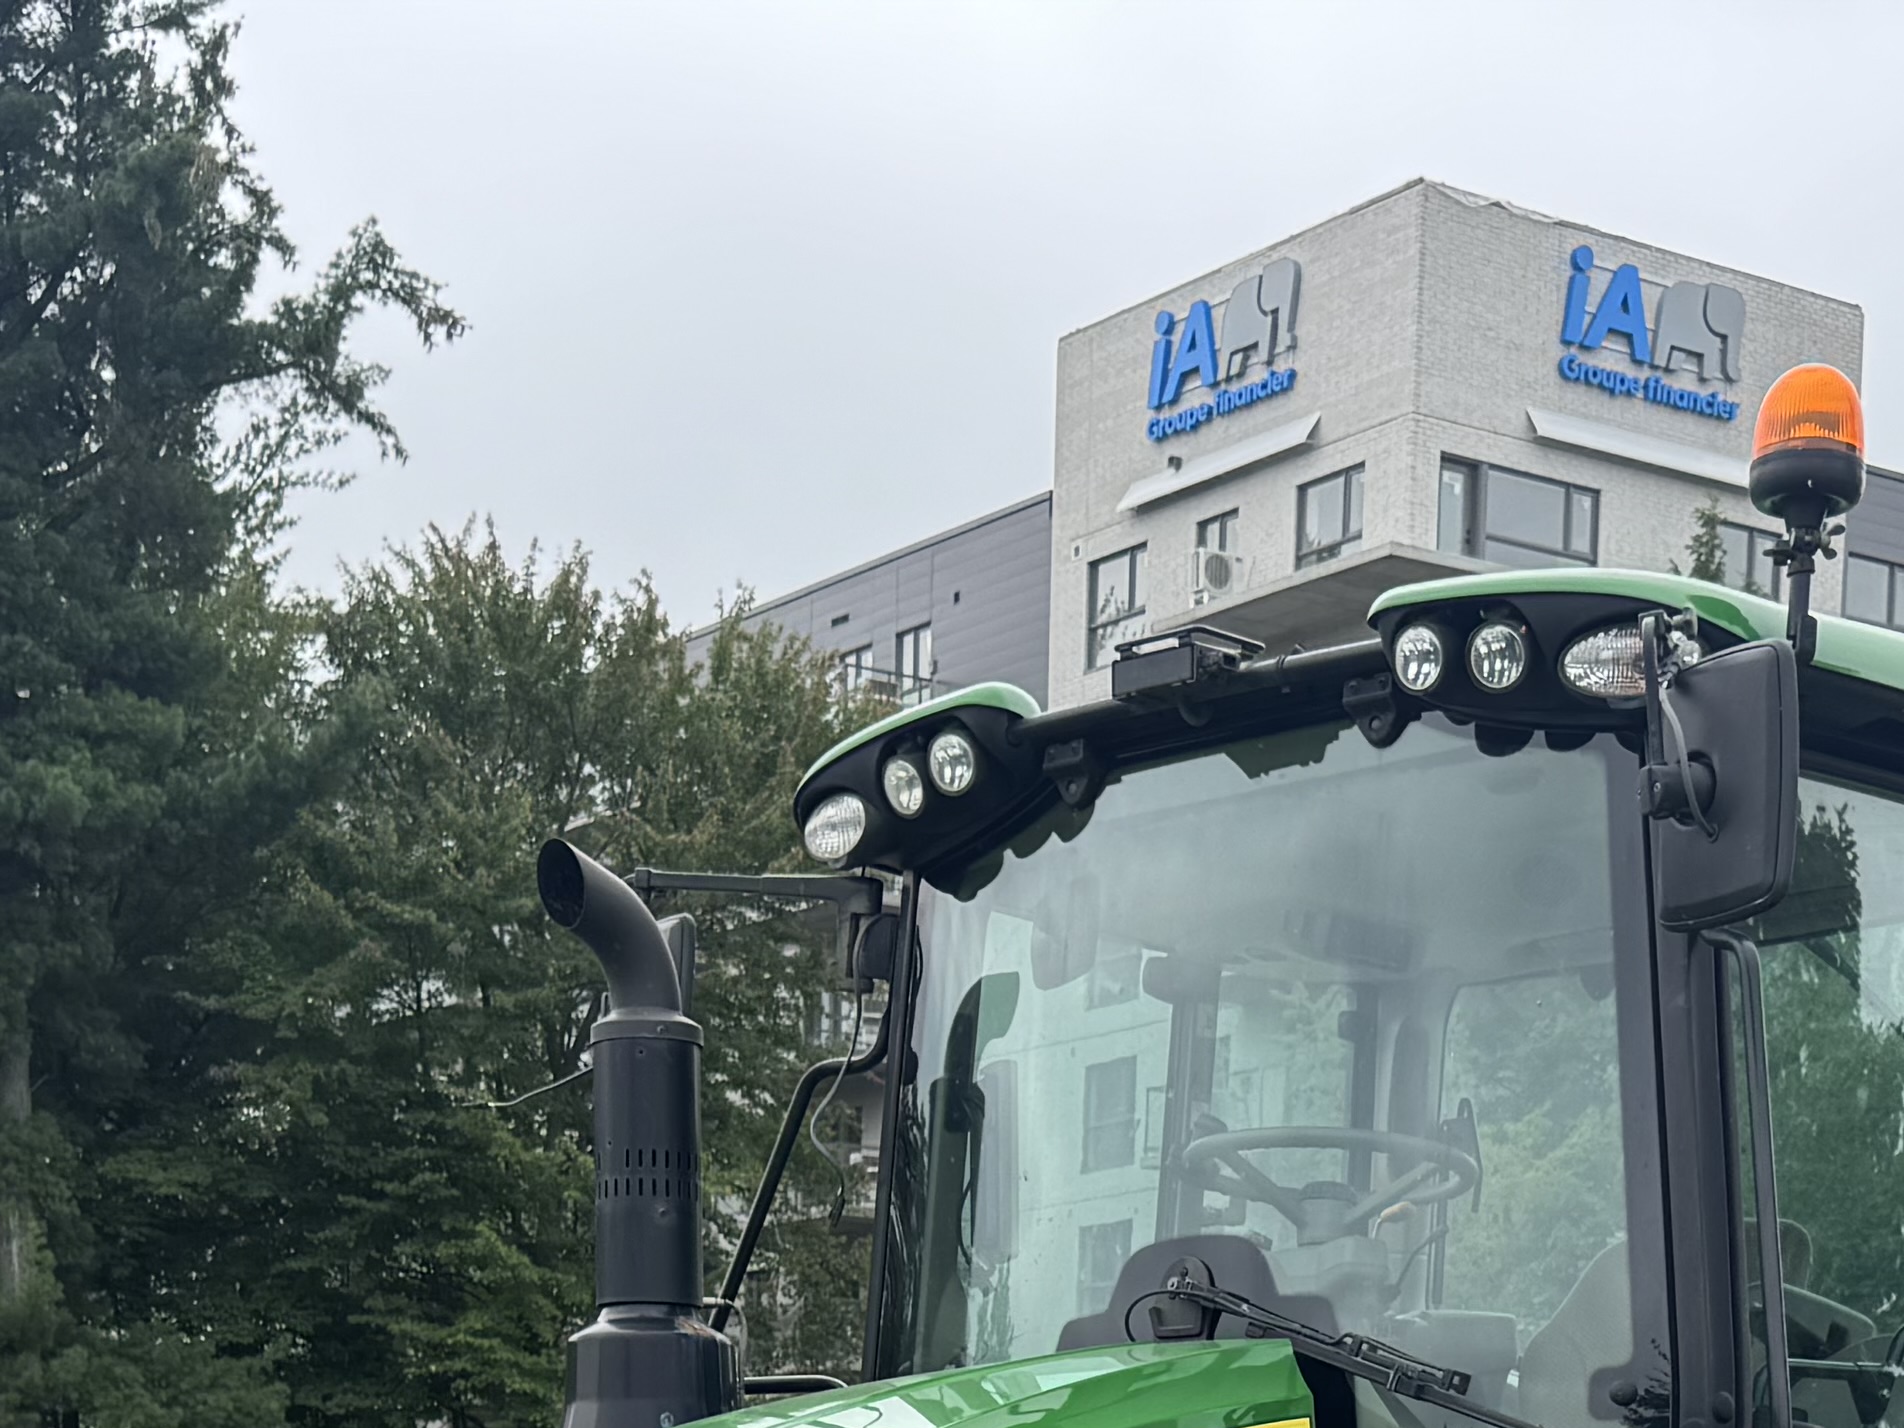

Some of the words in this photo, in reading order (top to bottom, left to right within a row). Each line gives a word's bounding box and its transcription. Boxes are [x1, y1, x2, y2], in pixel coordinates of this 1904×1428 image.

[1560, 245, 1653, 365] iA
[1148, 299, 1219, 411] iA
[1559, 353, 1643, 398] Groupe
[1642, 374, 1740, 422] financier
[1147, 403, 1213, 442] Groupe
[1212, 368, 1297, 418] financier
